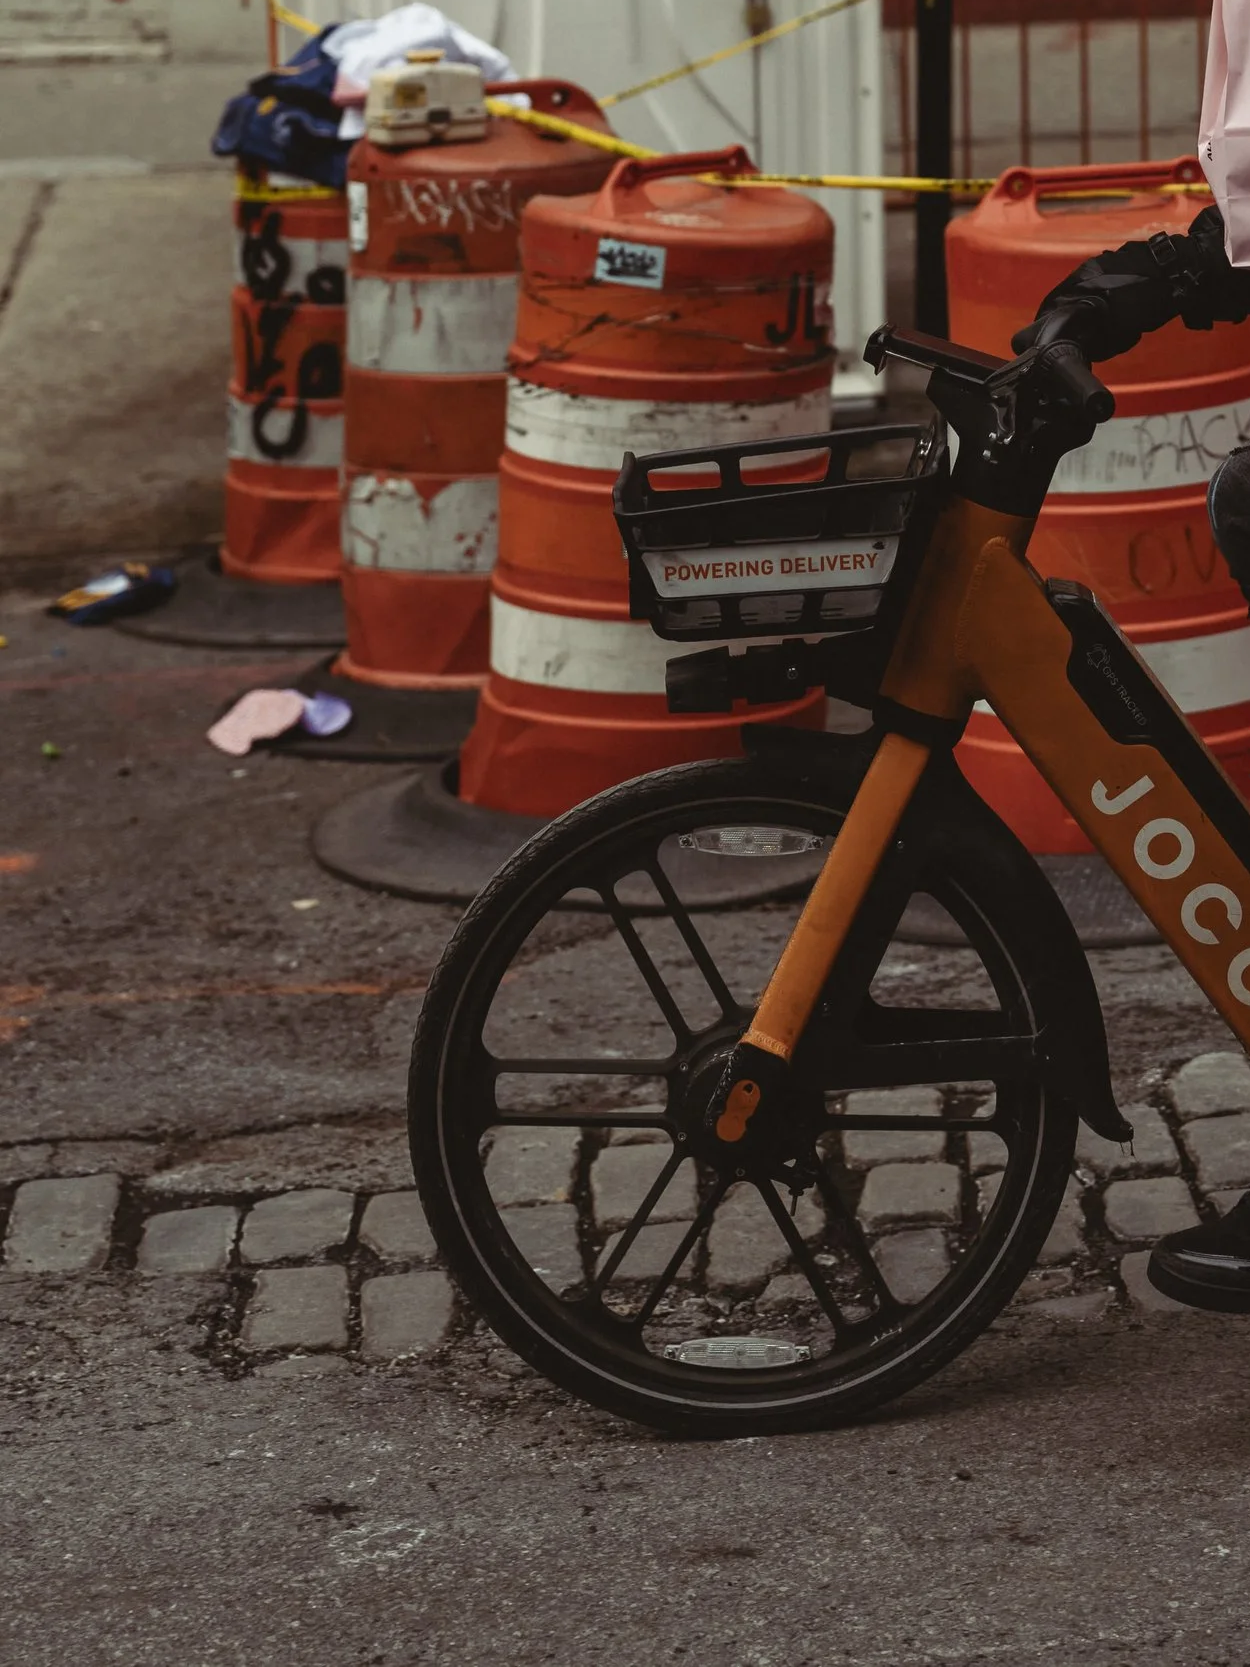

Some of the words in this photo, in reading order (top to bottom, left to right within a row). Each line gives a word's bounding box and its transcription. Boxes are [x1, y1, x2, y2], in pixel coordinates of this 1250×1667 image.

[664, 558, 774, 582] POWERING
[780, 552, 879, 576] DELIVERY
[1102, 665, 1120, 686] GPS
[1115, 684, 1148, 726] TRACKED
